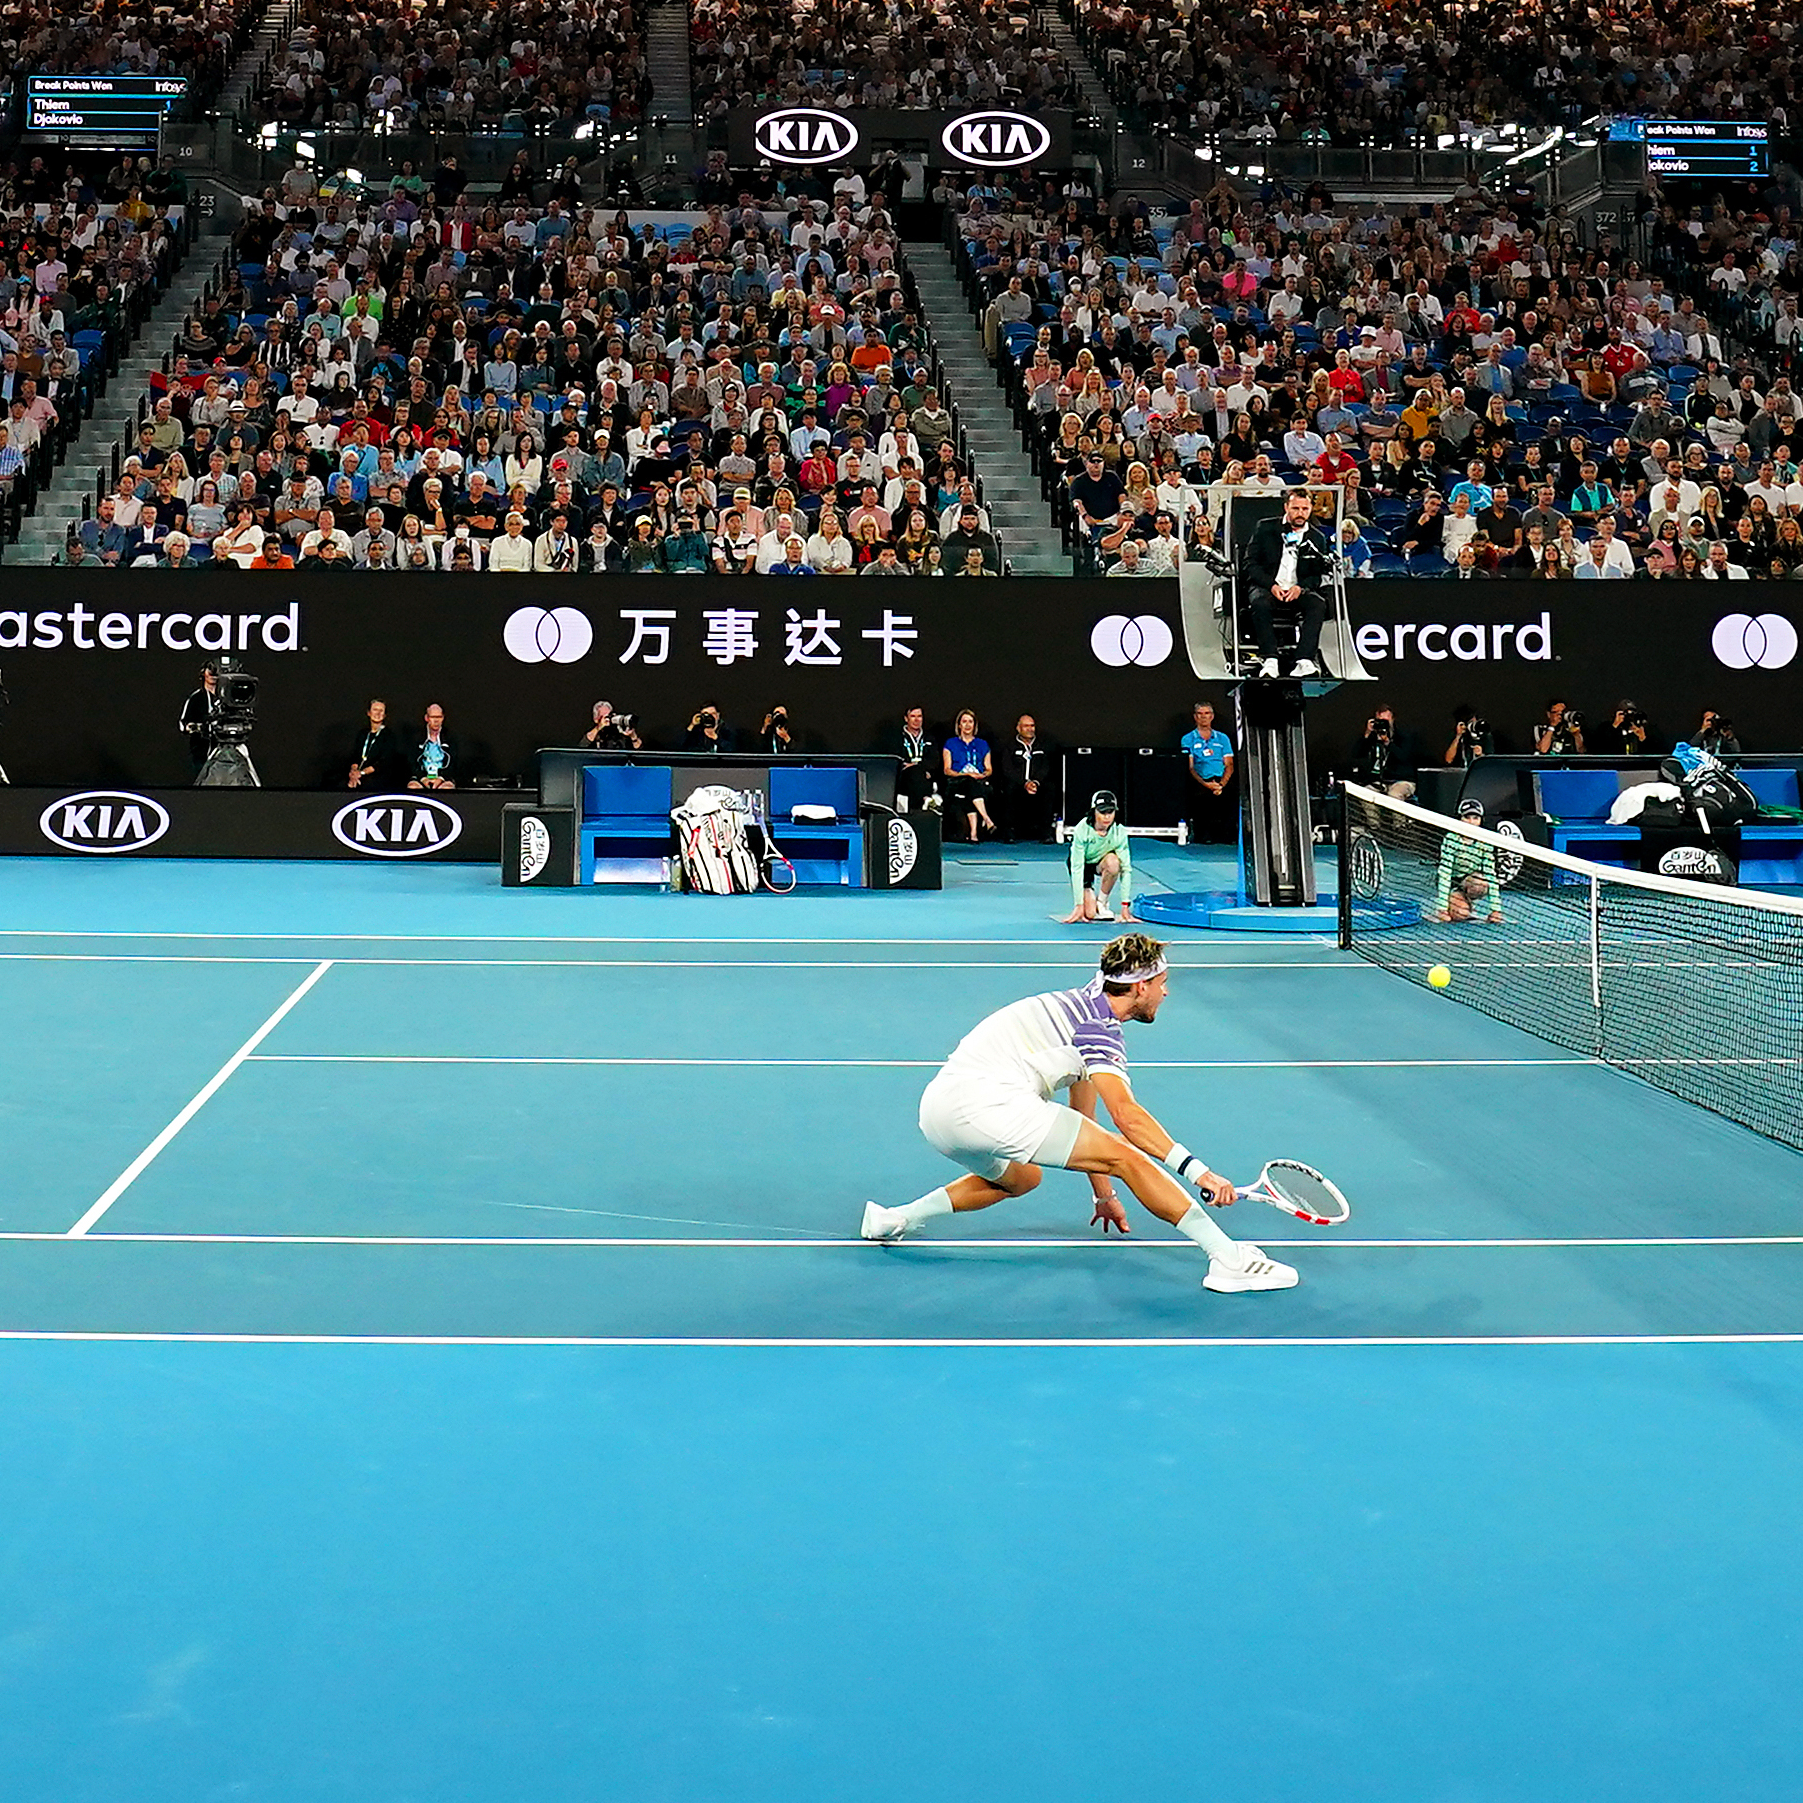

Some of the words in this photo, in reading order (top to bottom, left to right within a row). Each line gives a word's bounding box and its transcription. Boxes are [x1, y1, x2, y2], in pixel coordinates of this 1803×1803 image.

[34, 80, 61, 90] Break
[62, 81, 90, 90] Points
[91, 81, 113, 90] Won
[34, 99, 70, 110] Thiem
[769, 122, 840, 153] KIA
[1665, 126, 1693, 135] Points
[1694, 126, 1716, 135] Won
[1737, 126, 1768, 138] Infosys
[960, 124, 1031, 155] KIA
[179, 147, 193, 157] 10
[1647, 145, 1675, 155] hiem
[1749, 145, 1758, 156] 1
[664, 155, 677, 164] 11
[1132, 158, 1145, 168] 12
[1647, 159, 1690, 172] jokovic
[1749, 161, 1758, 172] 2
[199, 195, 215, 207] 23
[1595, 211, 1616, 222] 372
[619, 608, 919, 667] 万事达卡
[1355, 611, 1552, 661] ercard
[61, 805, 147, 840] KIA
[354, 808, 440, 843] KIA
